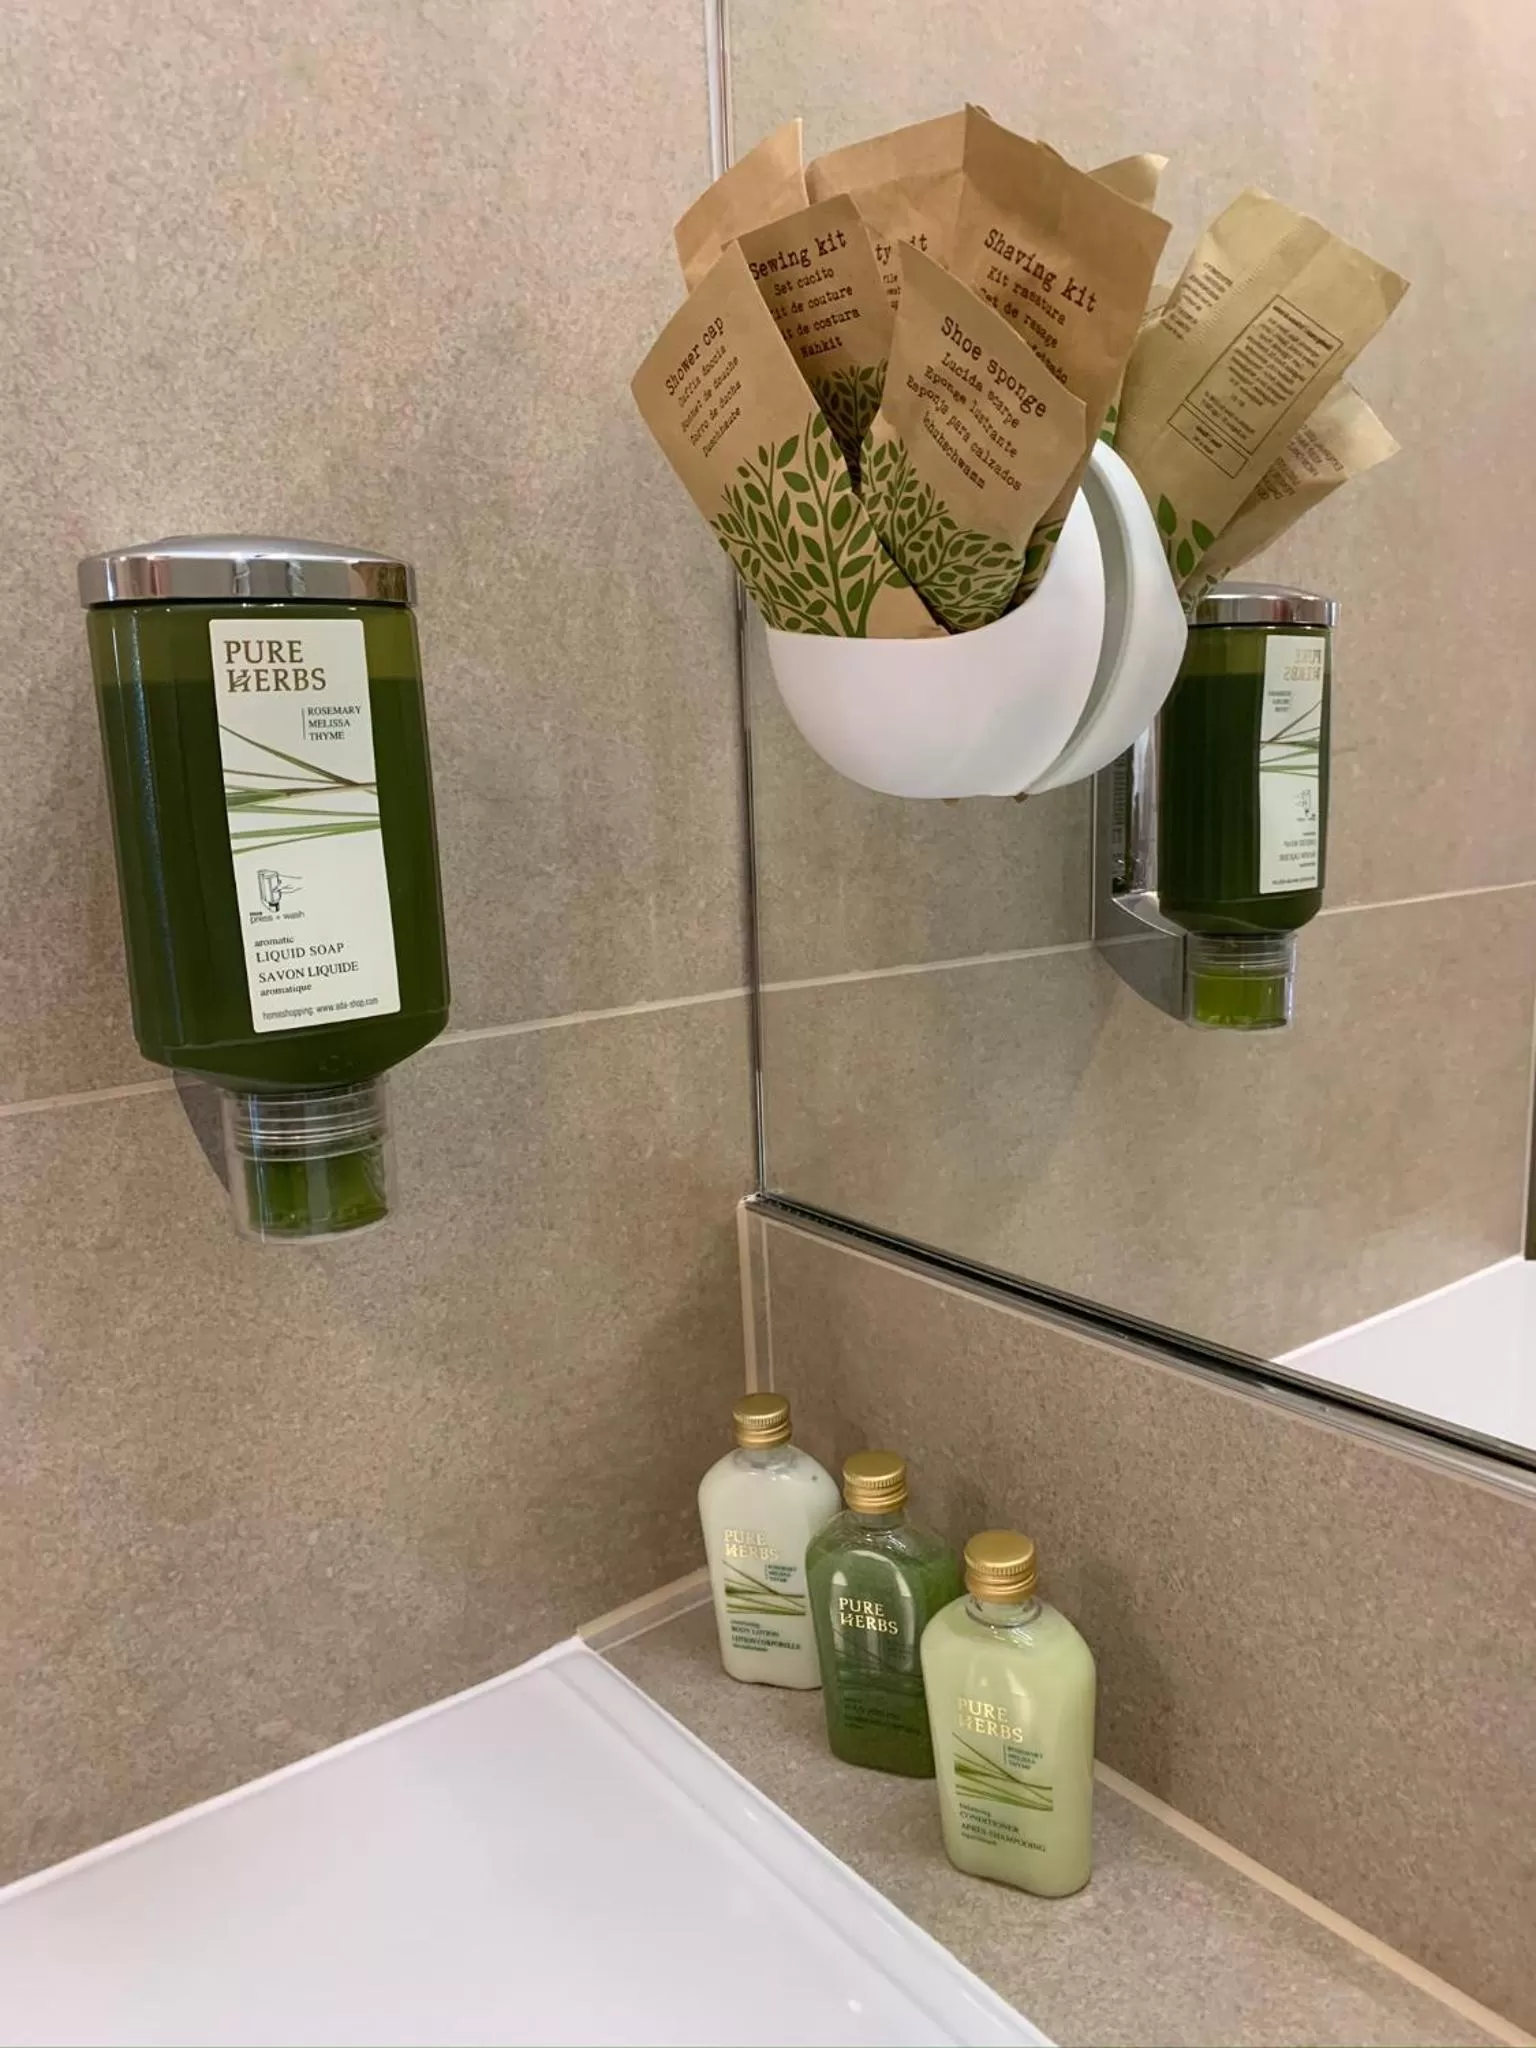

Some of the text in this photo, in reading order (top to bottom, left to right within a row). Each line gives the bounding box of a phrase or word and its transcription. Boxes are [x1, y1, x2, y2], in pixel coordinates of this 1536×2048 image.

[748, 248, 812, 281] Sewing
[814, 229, 847, 257] kit
[773, 267, 835, 296] Set cucito
[984, 227, 1097, 313] Shaving kit
[987, 265, 1009, 287] Kit
[771, 285, 853, 321] it de couture
[1004, 302, 1019, 319] de
[797, 324, 810, 336] de
[813, 309, 861, 331] costura
[665, 317, 724, 396] Shower cap
[941, 316, 1047, 418] Shoe sponge
[942, 352, 1020, 429] Lucida scarpe
[969, 400, 1018, 458] lustrante
[947, 415, 970, 443] para
[970, 443, 1022, 491] calzados
[224, 640, 304, 664] PURE
[226, 668, 327, 693] HERBS
[307, 705, 361, 716] ROSEMARY
[308, 719, 351, 728] MELISSA
[309, 731, 345, 741] THYME
[254, 937, 294, 947] aromatic
[256, 943, 344, 963] LIQUID SOAP
[259, 961, 359, 983] SAVON LIQUIDE
[260, 983, 312, 996] aromatique
[724, 1529, 767, 1545] PURE
[724, 1543, 779, 1561] HERBS
[839, 1597, 885, 1617] PURE
[840, 1612, 898, 1635] HERBS
[958, 1697, 1008, 1722] PURE
[959, 1714, 1024, 1743] HERBS
